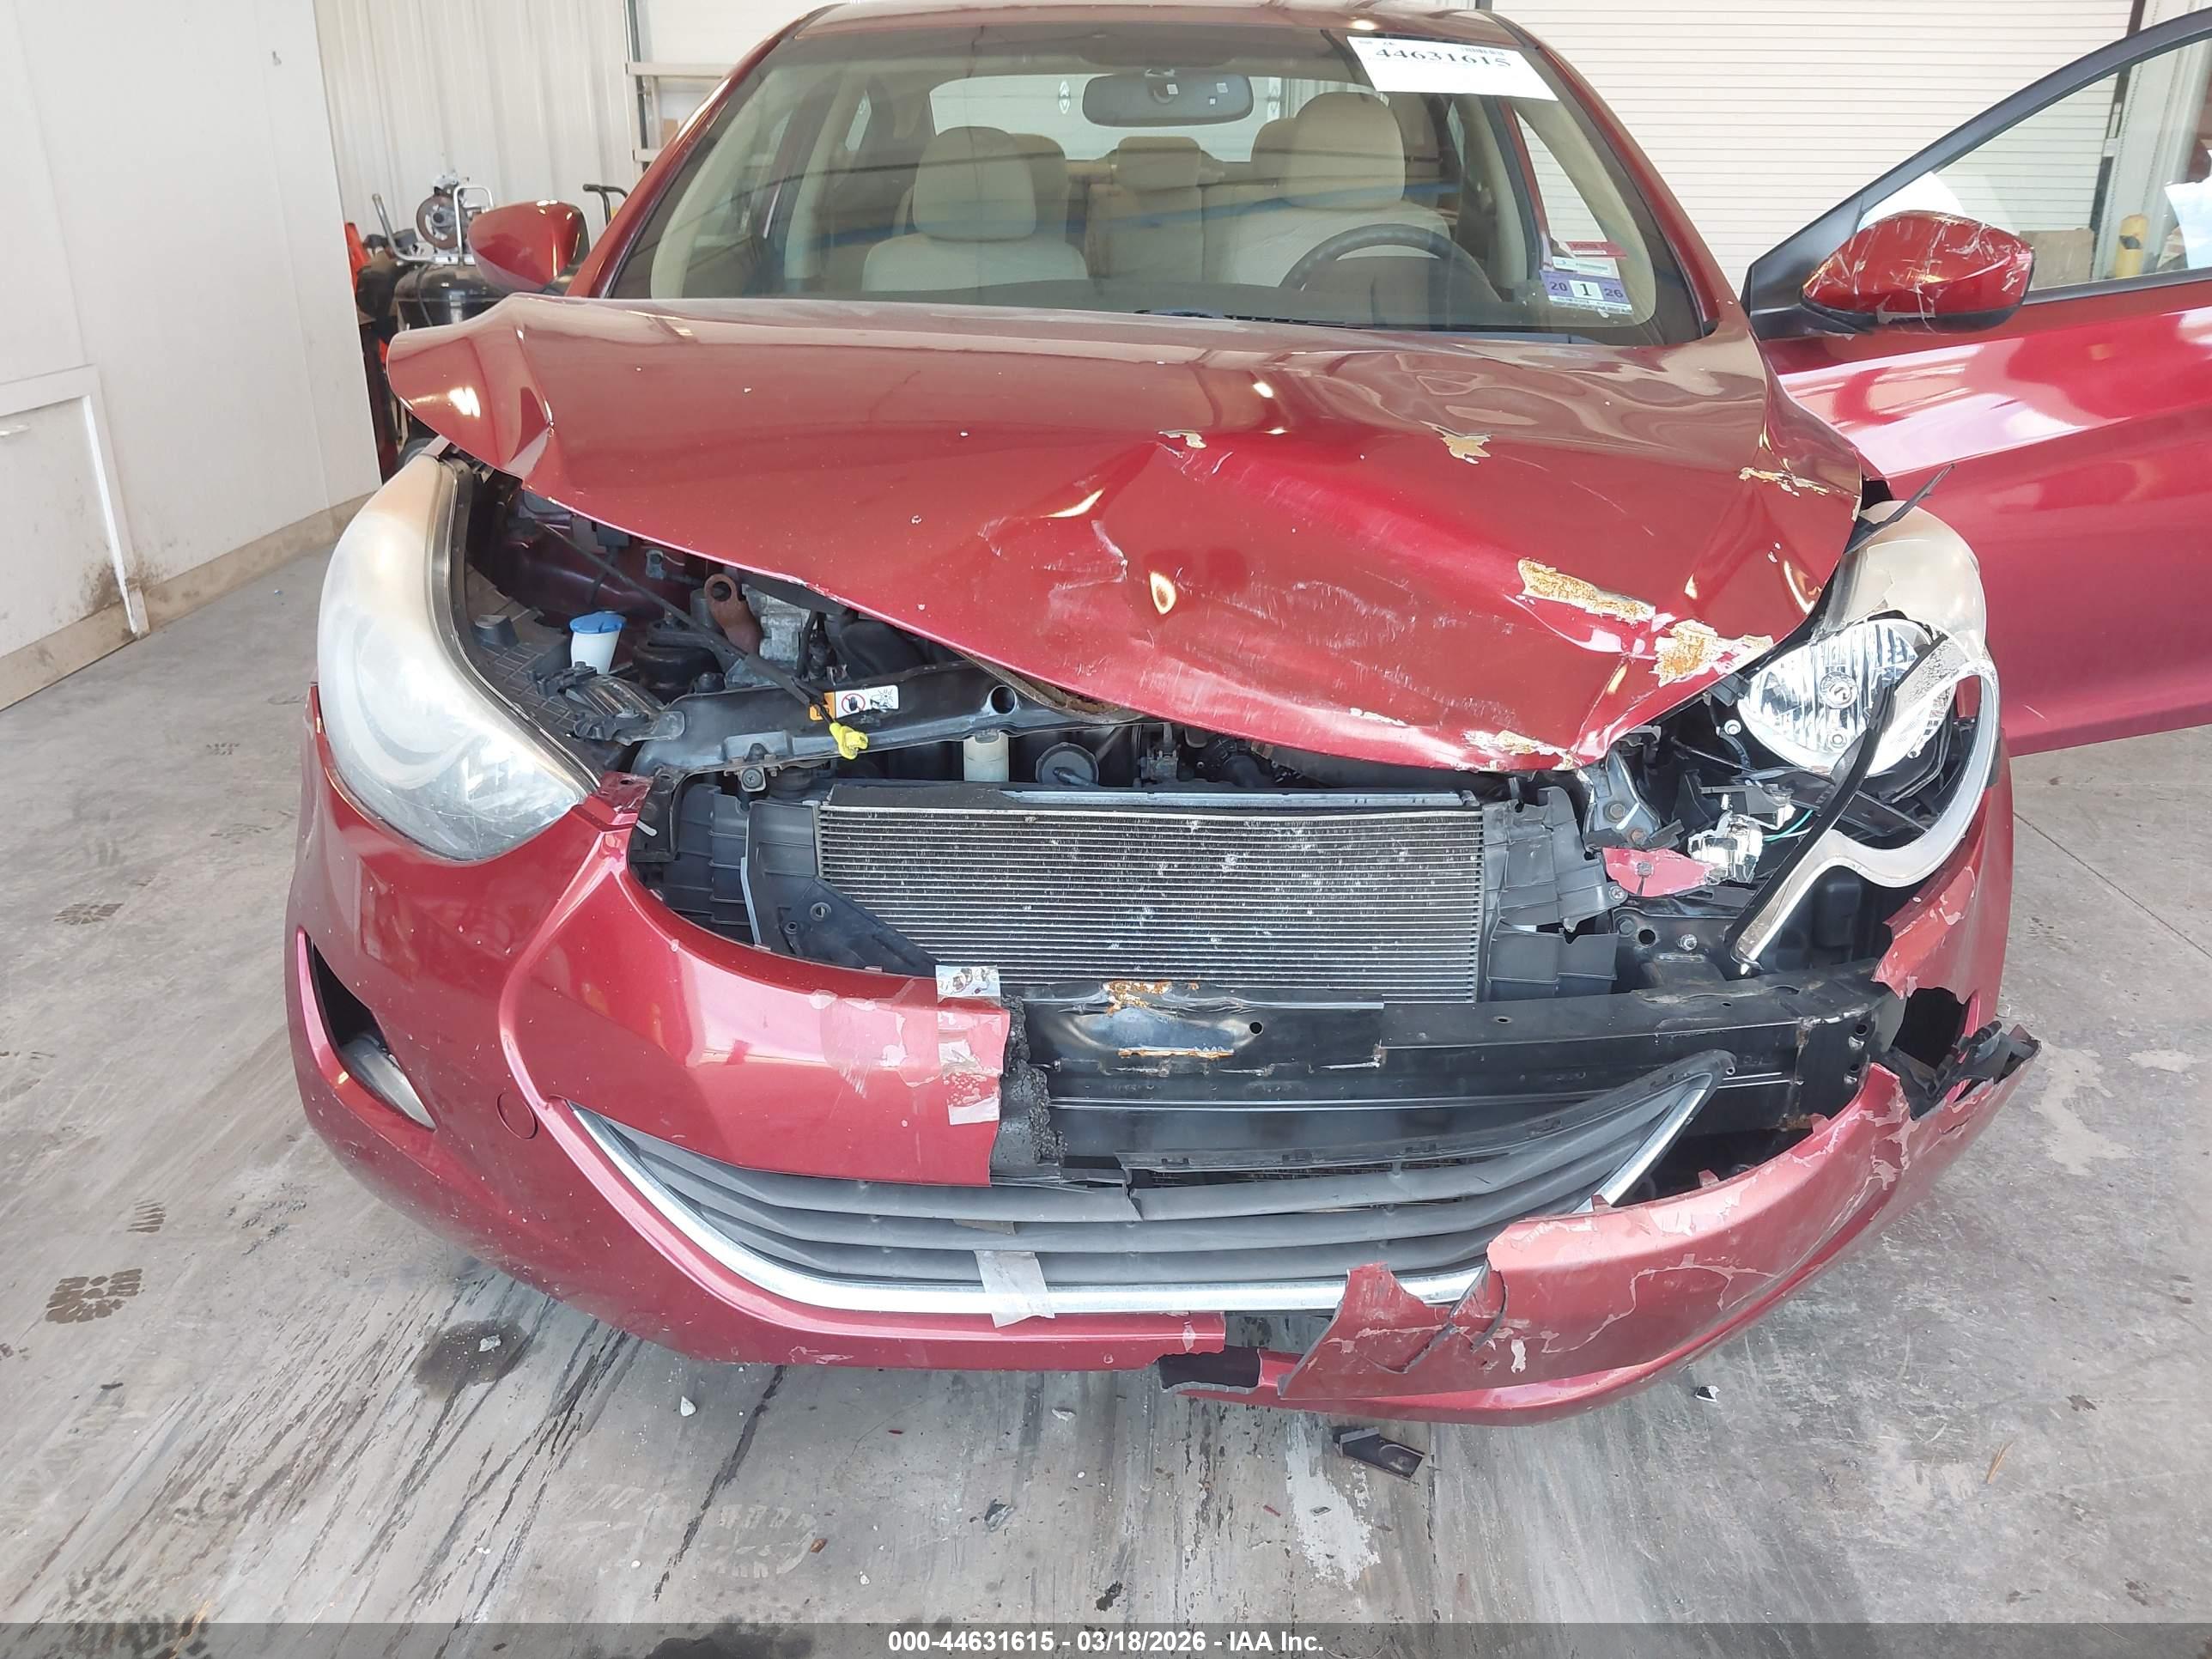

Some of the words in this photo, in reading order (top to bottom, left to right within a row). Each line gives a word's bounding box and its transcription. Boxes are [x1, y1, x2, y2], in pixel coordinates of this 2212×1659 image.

[1376, 48, 1511, 67] 44631615
[1549, 282, 1568, 292] 20
[1580, 283, 1592, 296] 1
[1604, 289, 1624, 298] 26
